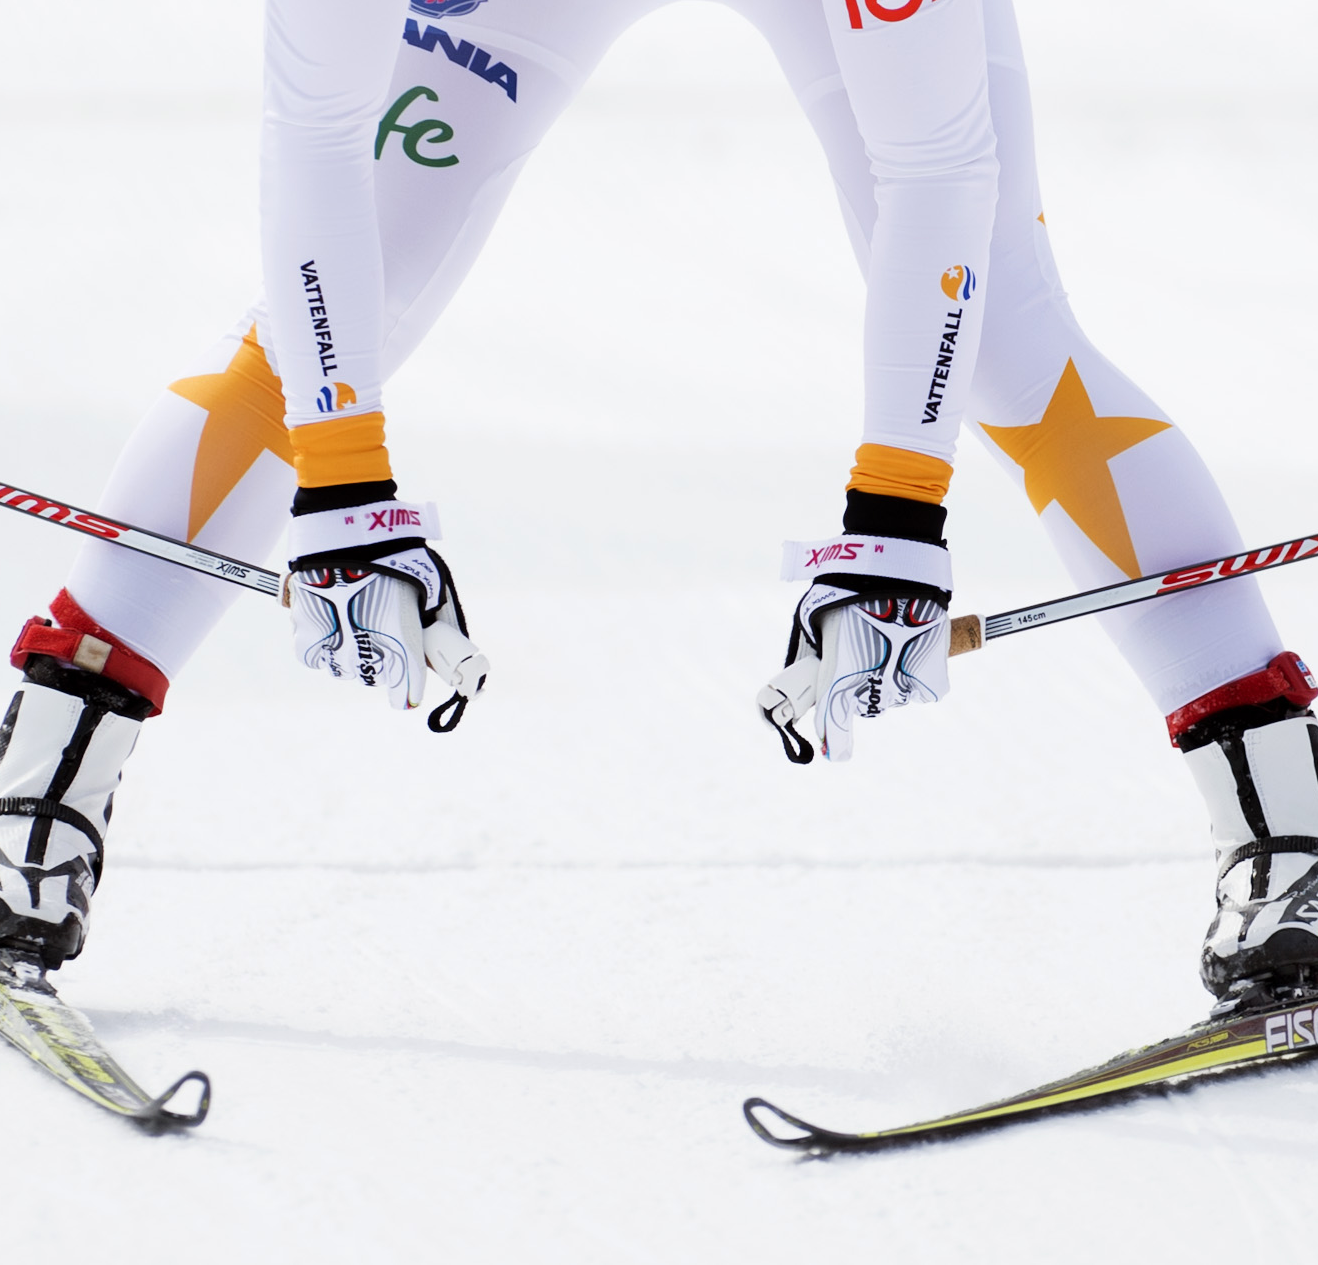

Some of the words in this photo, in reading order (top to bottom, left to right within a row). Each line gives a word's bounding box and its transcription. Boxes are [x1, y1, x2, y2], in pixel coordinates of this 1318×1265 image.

[300, 259, 338, 377] VATTENFALL
[921, 308, 963, 425] VATTENFALL
[1017, 612, 1047, 625] 145cm
